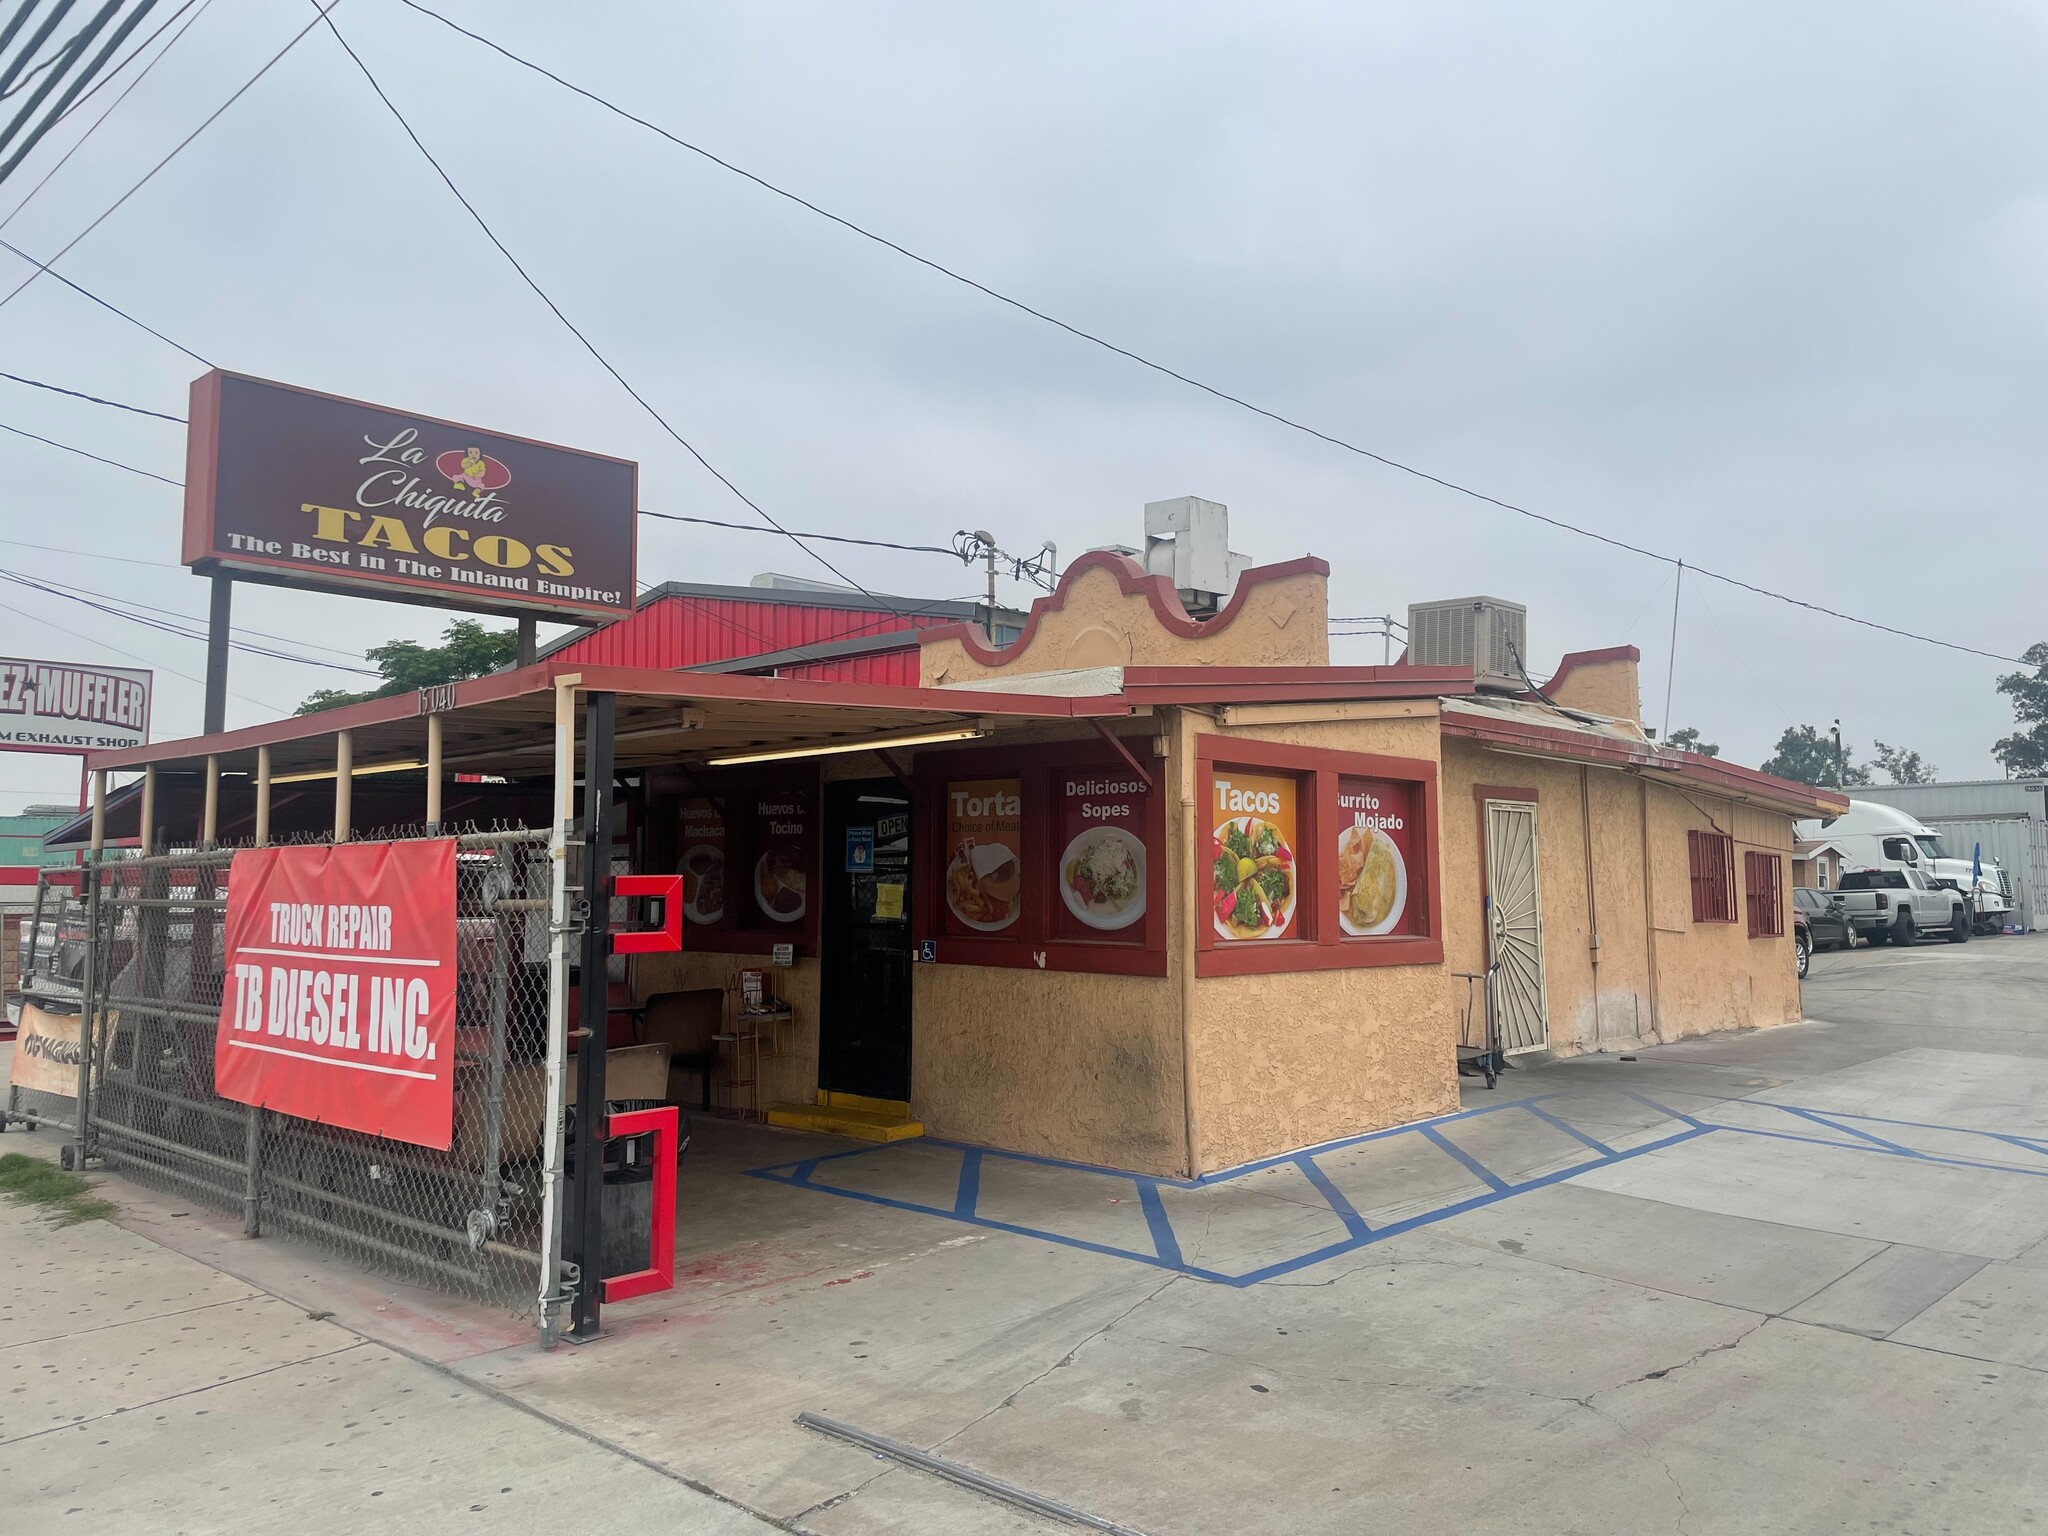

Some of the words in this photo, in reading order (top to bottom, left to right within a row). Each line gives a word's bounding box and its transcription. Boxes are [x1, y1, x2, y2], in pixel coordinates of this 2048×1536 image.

[359, 428, 429, 469] La
[356, 469, 512, 529] Chiquita
[301, 503, 575, 577] TACOS
[227, 533, 282, 555] The
[291, 542, 351, 566] Best
[359, 552, 386, 571] in
[394, 557, 443, 578] The
[450, 567, 529, 591] Inland
[537, 579, 621, 604] Empire!
[36, 666, 144, 731] MUFFLER
[416, 682, 456, 716] 15040
[15, 732, 94, 746] EXHAUST
[97, 737, 139, 748] SHOP
[1066, 780, 1147, 797] Deliciosos
[1215, 780, 1280, 815] Tacos
[680, 807, 712, 820] Huevos
[758, 802, 794, 816] Huevos
[951, 790, 1021, 817] Torta
[1081, 802, 1130, 820] Sopes
[685, 825, 725, 838] Machaca
[769, 821, 803, 835] Tocino
[881, 816, 908, 835] OPEN
[952, 820, 983, 833] Choice
[985, 820, 995, 832] of
[1354, 812, 1404, 834] Mojado
[270, 902, 324, 947] TRUCK
[326, 905, 392, 951] REPAIR
[234, 963, 264, 1032] TB
[267, 966, 361, 1050] DIESEL
[368, 976, 436, 1060] INC.
